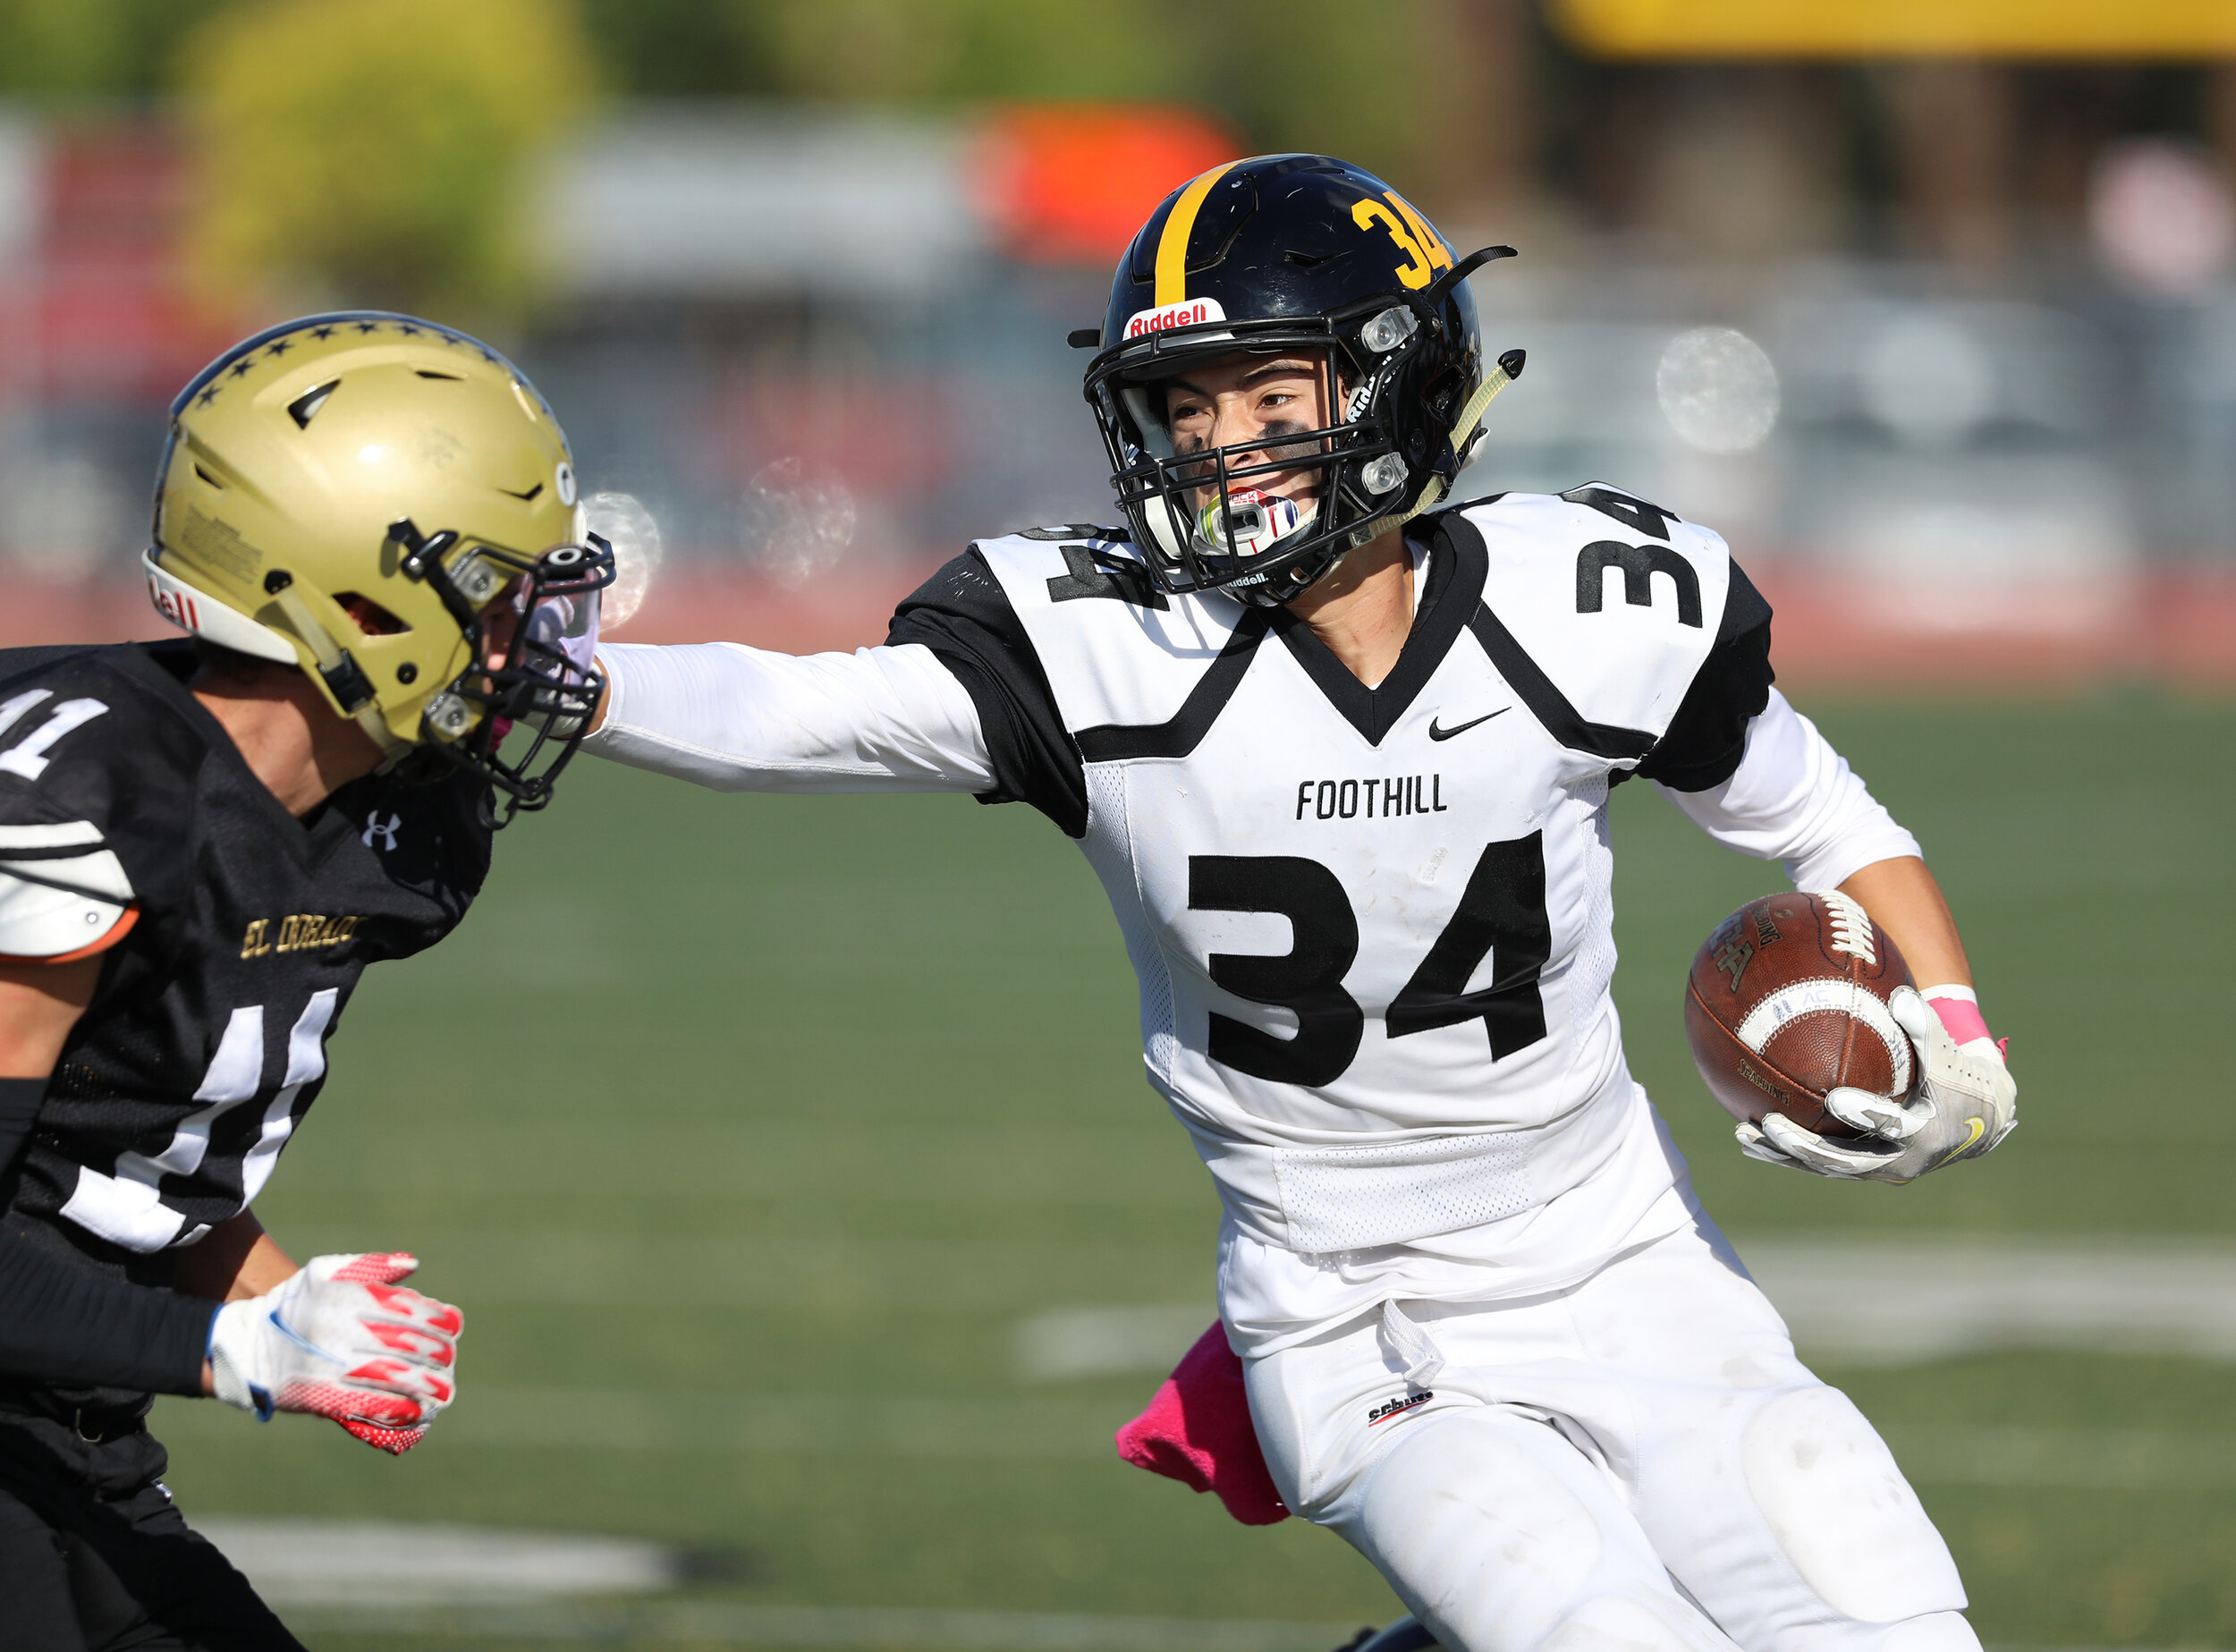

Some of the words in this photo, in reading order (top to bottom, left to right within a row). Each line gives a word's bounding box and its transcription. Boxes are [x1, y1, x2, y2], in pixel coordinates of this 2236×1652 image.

[1351, 191, 1454, 291] 34
[1131, 303, 1207, 338] Riddell
[1228, 491, 1257, 502] OCK
[1559, 487, 1703, 629] 34
[1296, 774, 1447, 820] FOOTHILL
[241, 918, 271, 961] EL
[276, 913, 368, 953] DORAD
[1749, 902, 1783, 948] LDING
[1188, 829, 1552, 1088] 34
[1738, 1059, 1790, 1106] SPALDING
[60, 987, 338, 1252] 11
